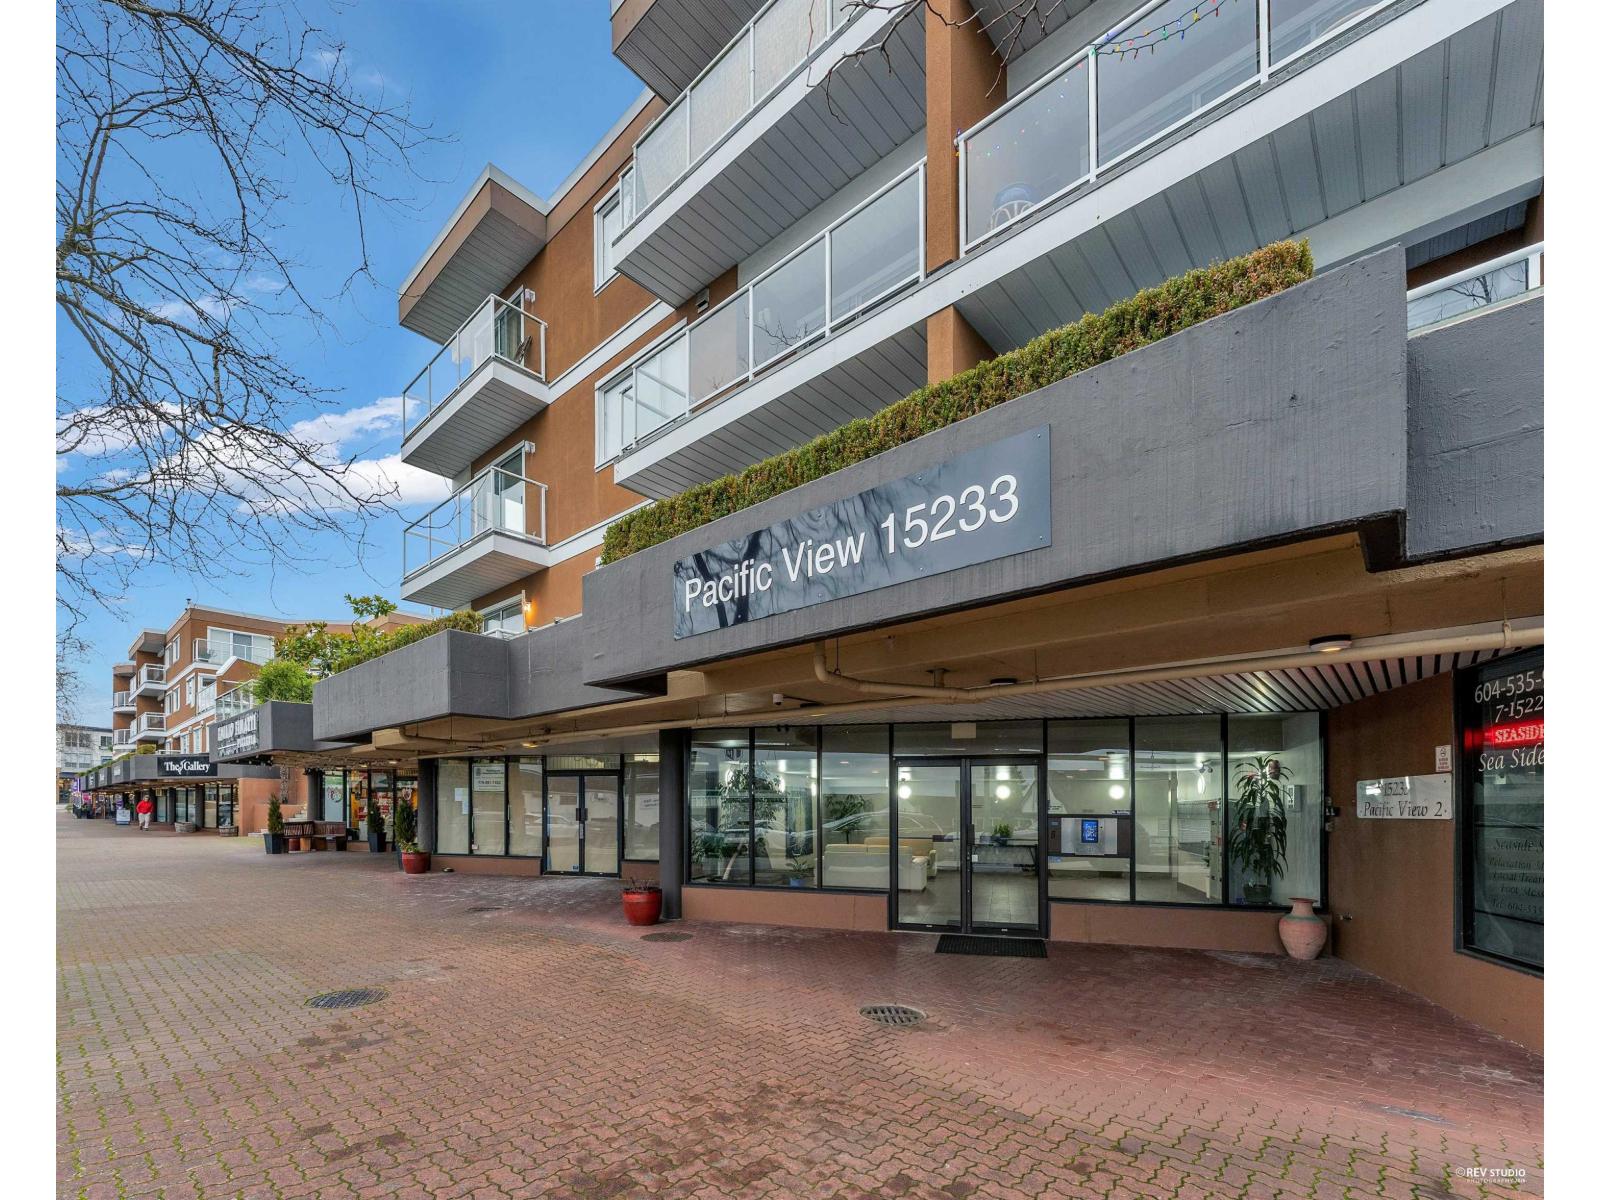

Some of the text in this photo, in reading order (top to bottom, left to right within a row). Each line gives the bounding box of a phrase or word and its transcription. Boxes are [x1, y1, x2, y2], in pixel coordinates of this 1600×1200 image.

[684, 474, 1019, 612] Pacific View 15233
[164, 760, 211, 773] The Gallery
[1478, 742, 1544, 772] Sea Side
[1364, 800, 1443, 817] Pacific View 2
